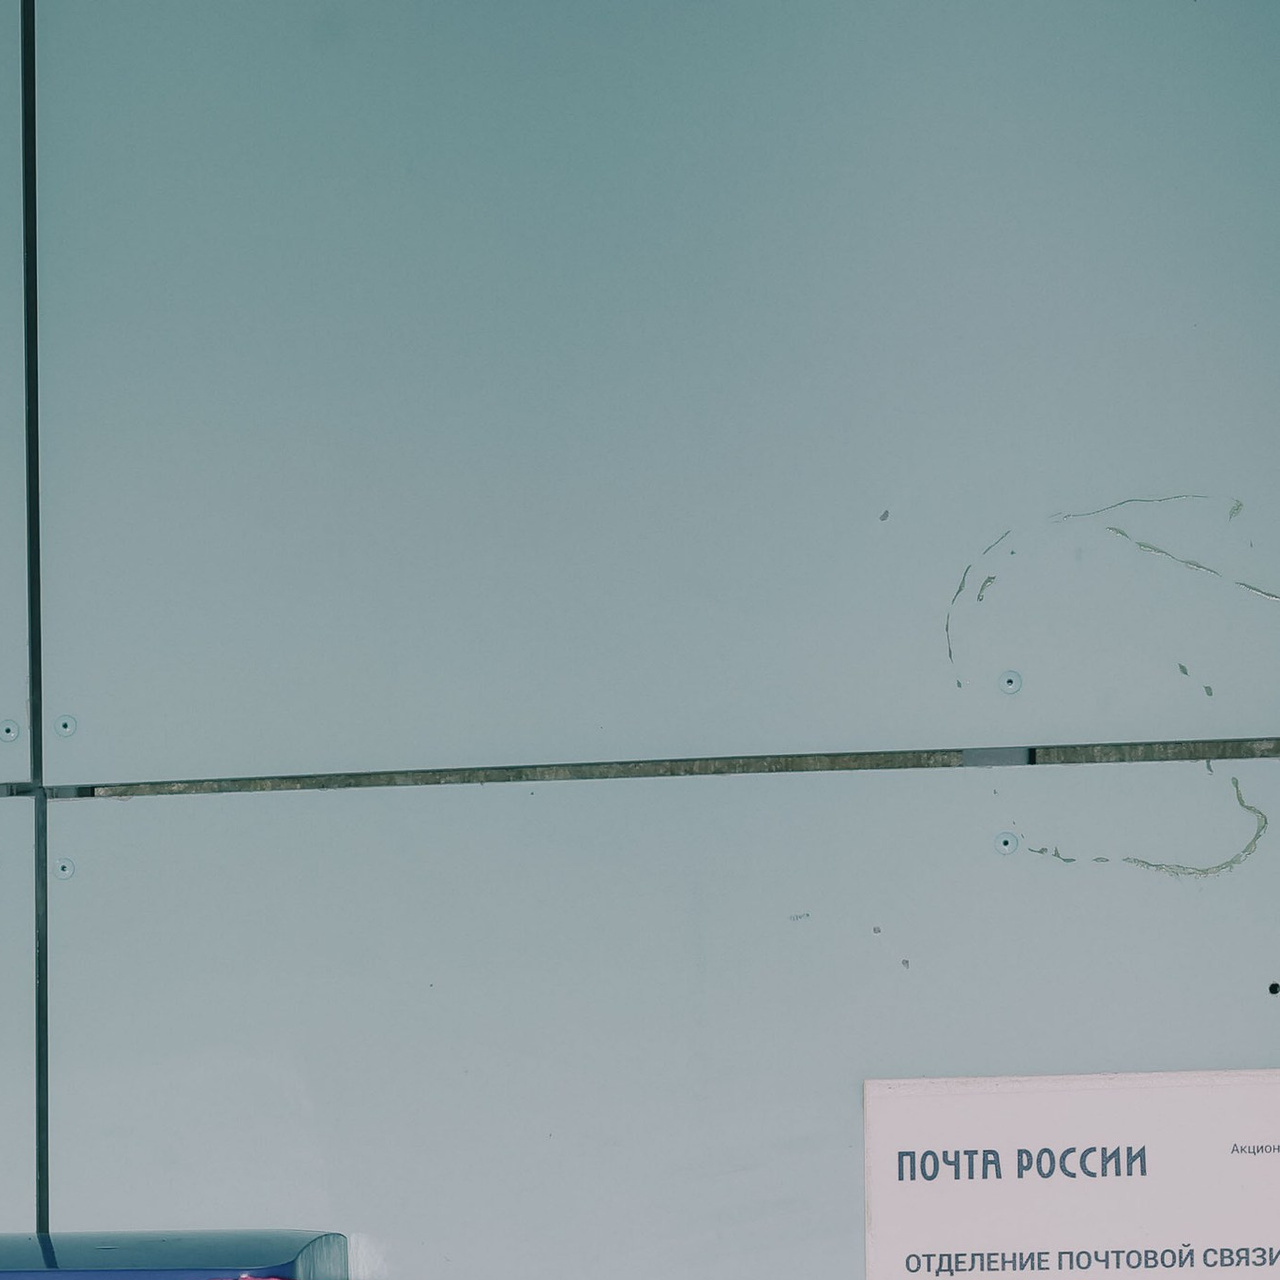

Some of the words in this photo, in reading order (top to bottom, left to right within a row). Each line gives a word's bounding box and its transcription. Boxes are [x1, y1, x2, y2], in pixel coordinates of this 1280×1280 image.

[897, 1149, 1002, 1181] ПОЧТА
[1017, 1145, 1148, 1179] РОССИИ
[905, 1251, 1050, 1276] ОТДЕЛЕНИЕ
[1058, 1243, 1195, 1271] ПОЧТОВОЙ
